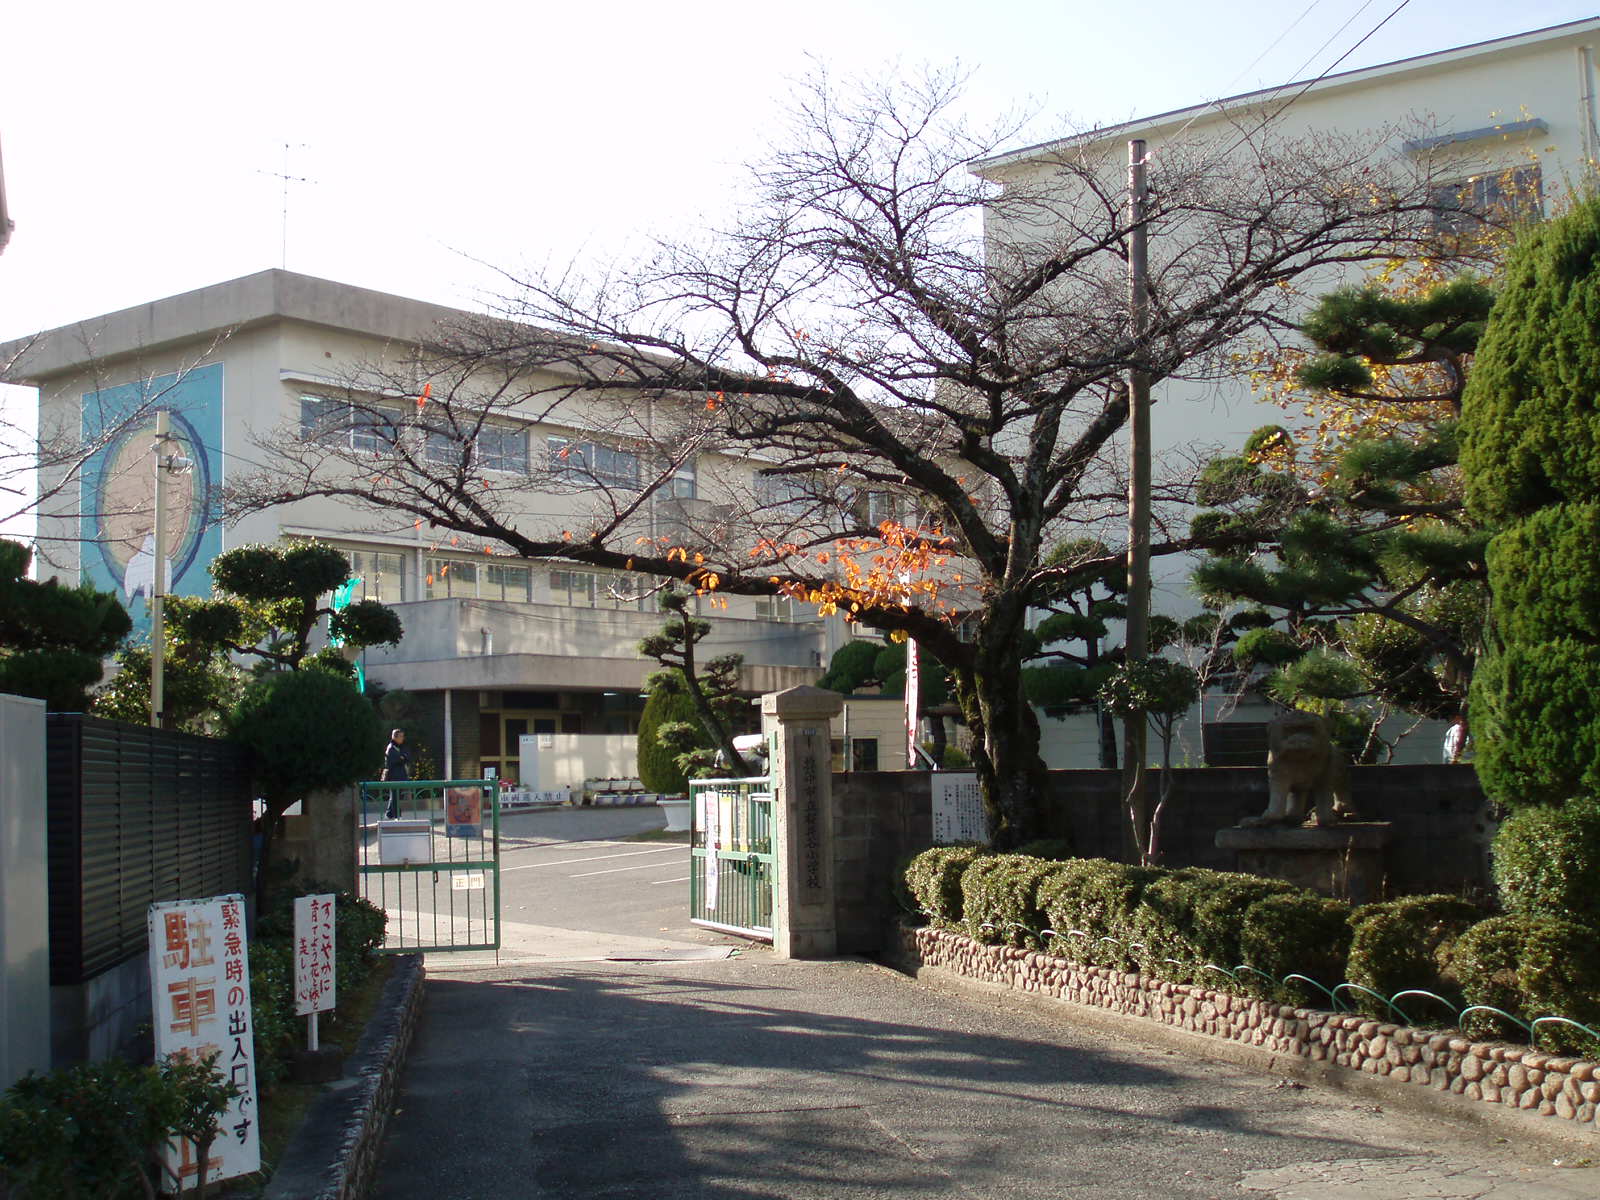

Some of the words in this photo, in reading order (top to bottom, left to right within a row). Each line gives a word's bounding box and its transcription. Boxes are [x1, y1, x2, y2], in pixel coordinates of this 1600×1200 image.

[298, 936, 309, 1001] 美しい心
[320, 902, 333, 993] すこやかに
[221, 900, 252, 1145] 緊急時の出入口です
